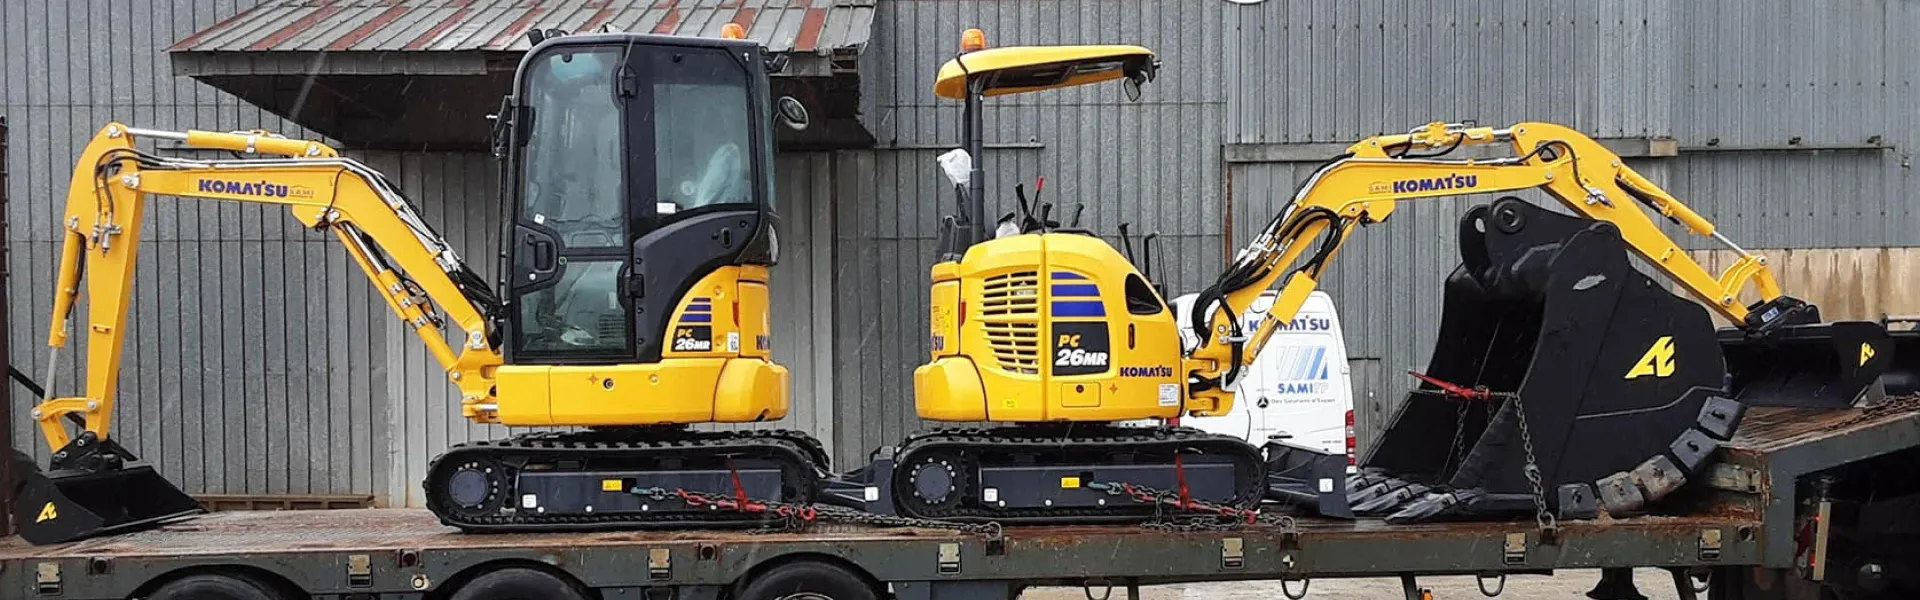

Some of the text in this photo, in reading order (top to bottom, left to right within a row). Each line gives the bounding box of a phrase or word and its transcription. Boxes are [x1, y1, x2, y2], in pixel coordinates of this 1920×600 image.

[199, 178, 288, 197] KOMATSU
[1393, 173, 1477, 193] KOMATSU
[677, 329, 693, 337] PC
[675, 338, 711, 350] 26MR
[1058, 334, 1081, 347] PC
[1055, 348, 1108, 366] 26MR
[1119, 365, 1173, 377] KOMATSU
